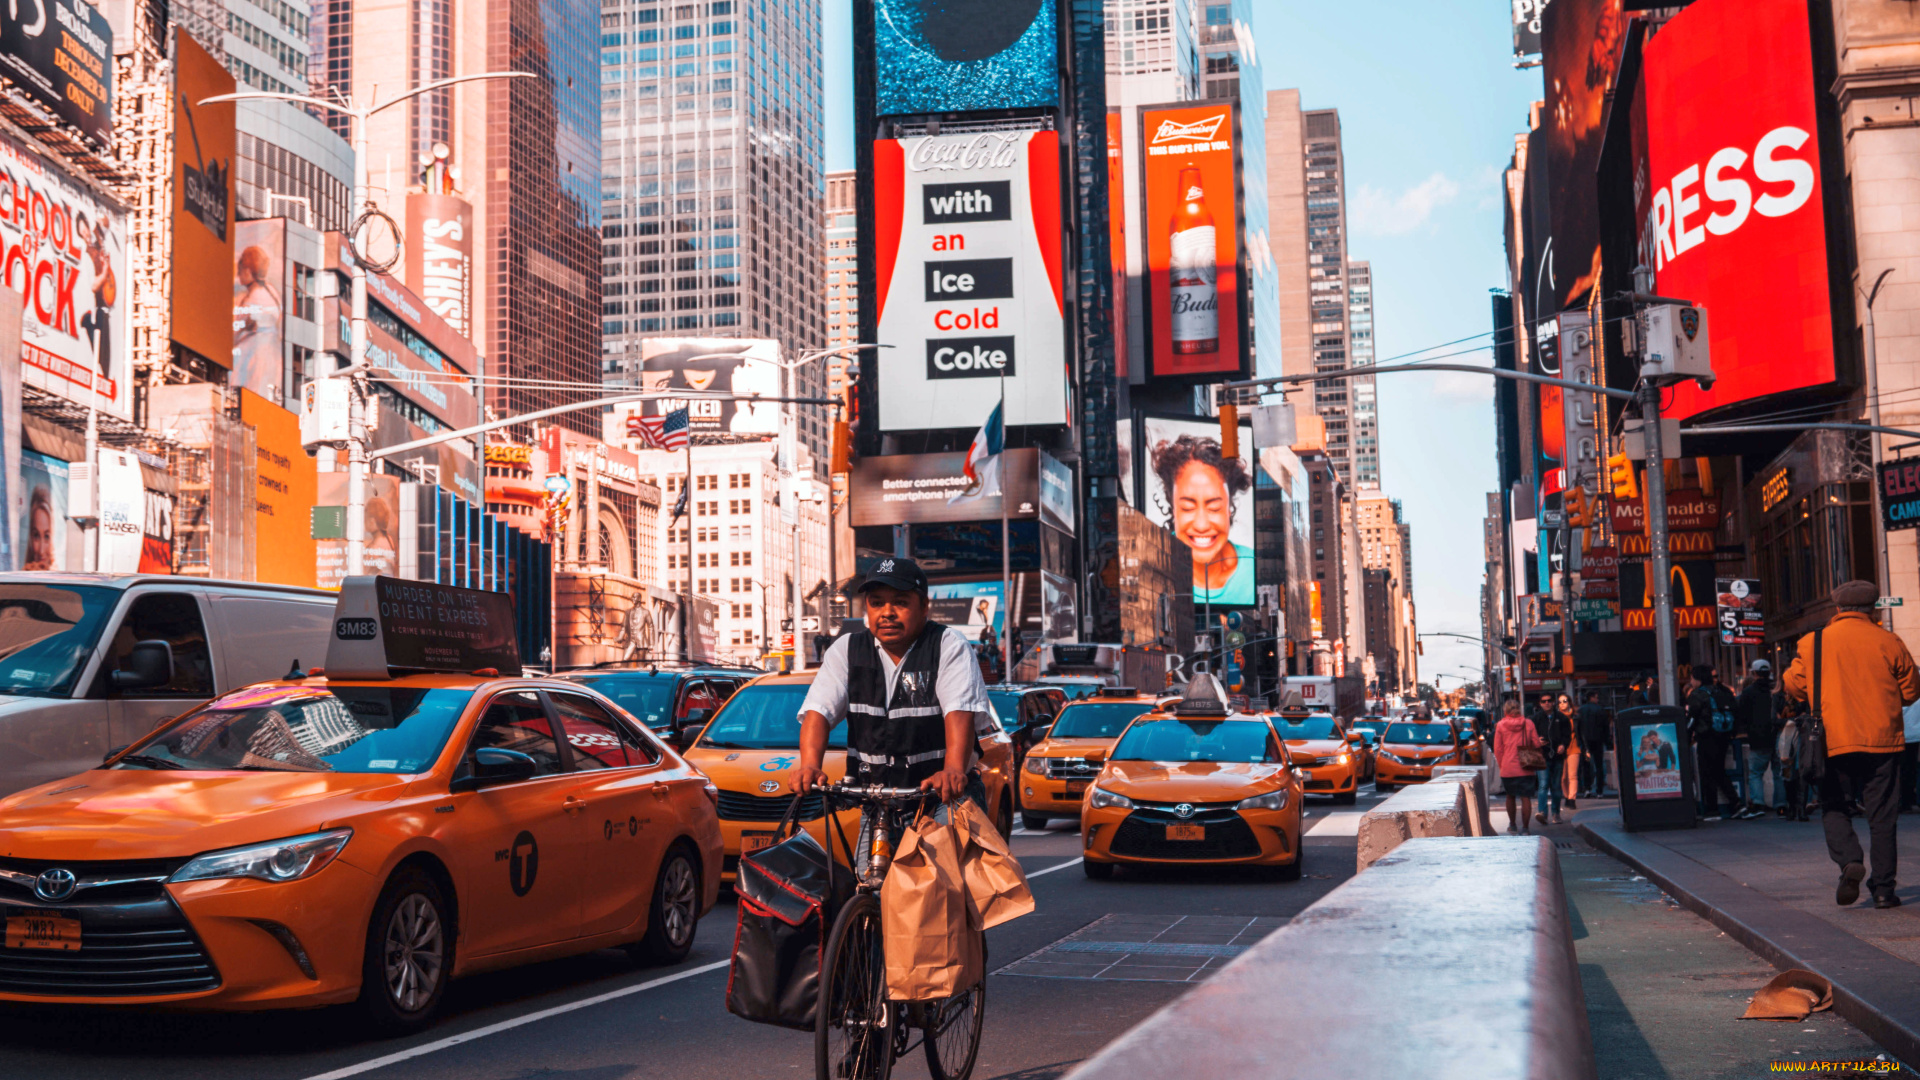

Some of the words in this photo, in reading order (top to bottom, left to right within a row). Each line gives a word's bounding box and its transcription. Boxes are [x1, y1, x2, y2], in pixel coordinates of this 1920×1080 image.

[56, 1, 108, 60] BROADWAY
[61, 30, 104, 79] THROUGH
[1158, 123, 1218, 138] Budweiser
[908, 132, 1022, 172] Coca-Cola
[1149, 145, 1168, 156] THIS
[1168, 144, 1193, 155] BUD'S
[1194, 142, 1210, 153] FOR
[1211, 140, 1230, 151] YOU.
[930, 189, 993, 215] with
[931, 233, 965, 251] an
[933, 269, 976, 293] Ice
[933, 306, 1000, 331] Cold
[340, 313, 352, 346] Th
[933, 345, 1008, 371] Coke
[272, 452, 291, 472] royalty
[259, 474, 281, 493] crowned
[282, 480, 289, 494] in
[882, 479, 913, 490] Better
[913, 476, 967, 488] connected
[882, 489, 943, 502] smartphone
[104, 511, 128, 522] EVAN
[1615, 502, 1717, 518] Mcnald's
[104, 521, 140, 534] HANSEN
[385, 585, 433, 603] MURDER
[437, 591, 454, 605] ON
[458, 593, 479, 609] THE
[1591, 600, 1601, 610] 46
[380, 602, 432, 620] ORIENT
[438, 607, 488, 627] EXPRESS
[337, 621, 377, 636] 3M83
[398, 626, 417, 635] CRIME
[420, 627, 437, 637] WITH
[438, 629, 443, 637] A
[444, 630, 465, 639] KILLER
[467, 631, 484, 640] TWIST
[1304, 686, 1314, 697] H
[495, 848, 509, 862] NYC
[516, 843, 533, 889] T
